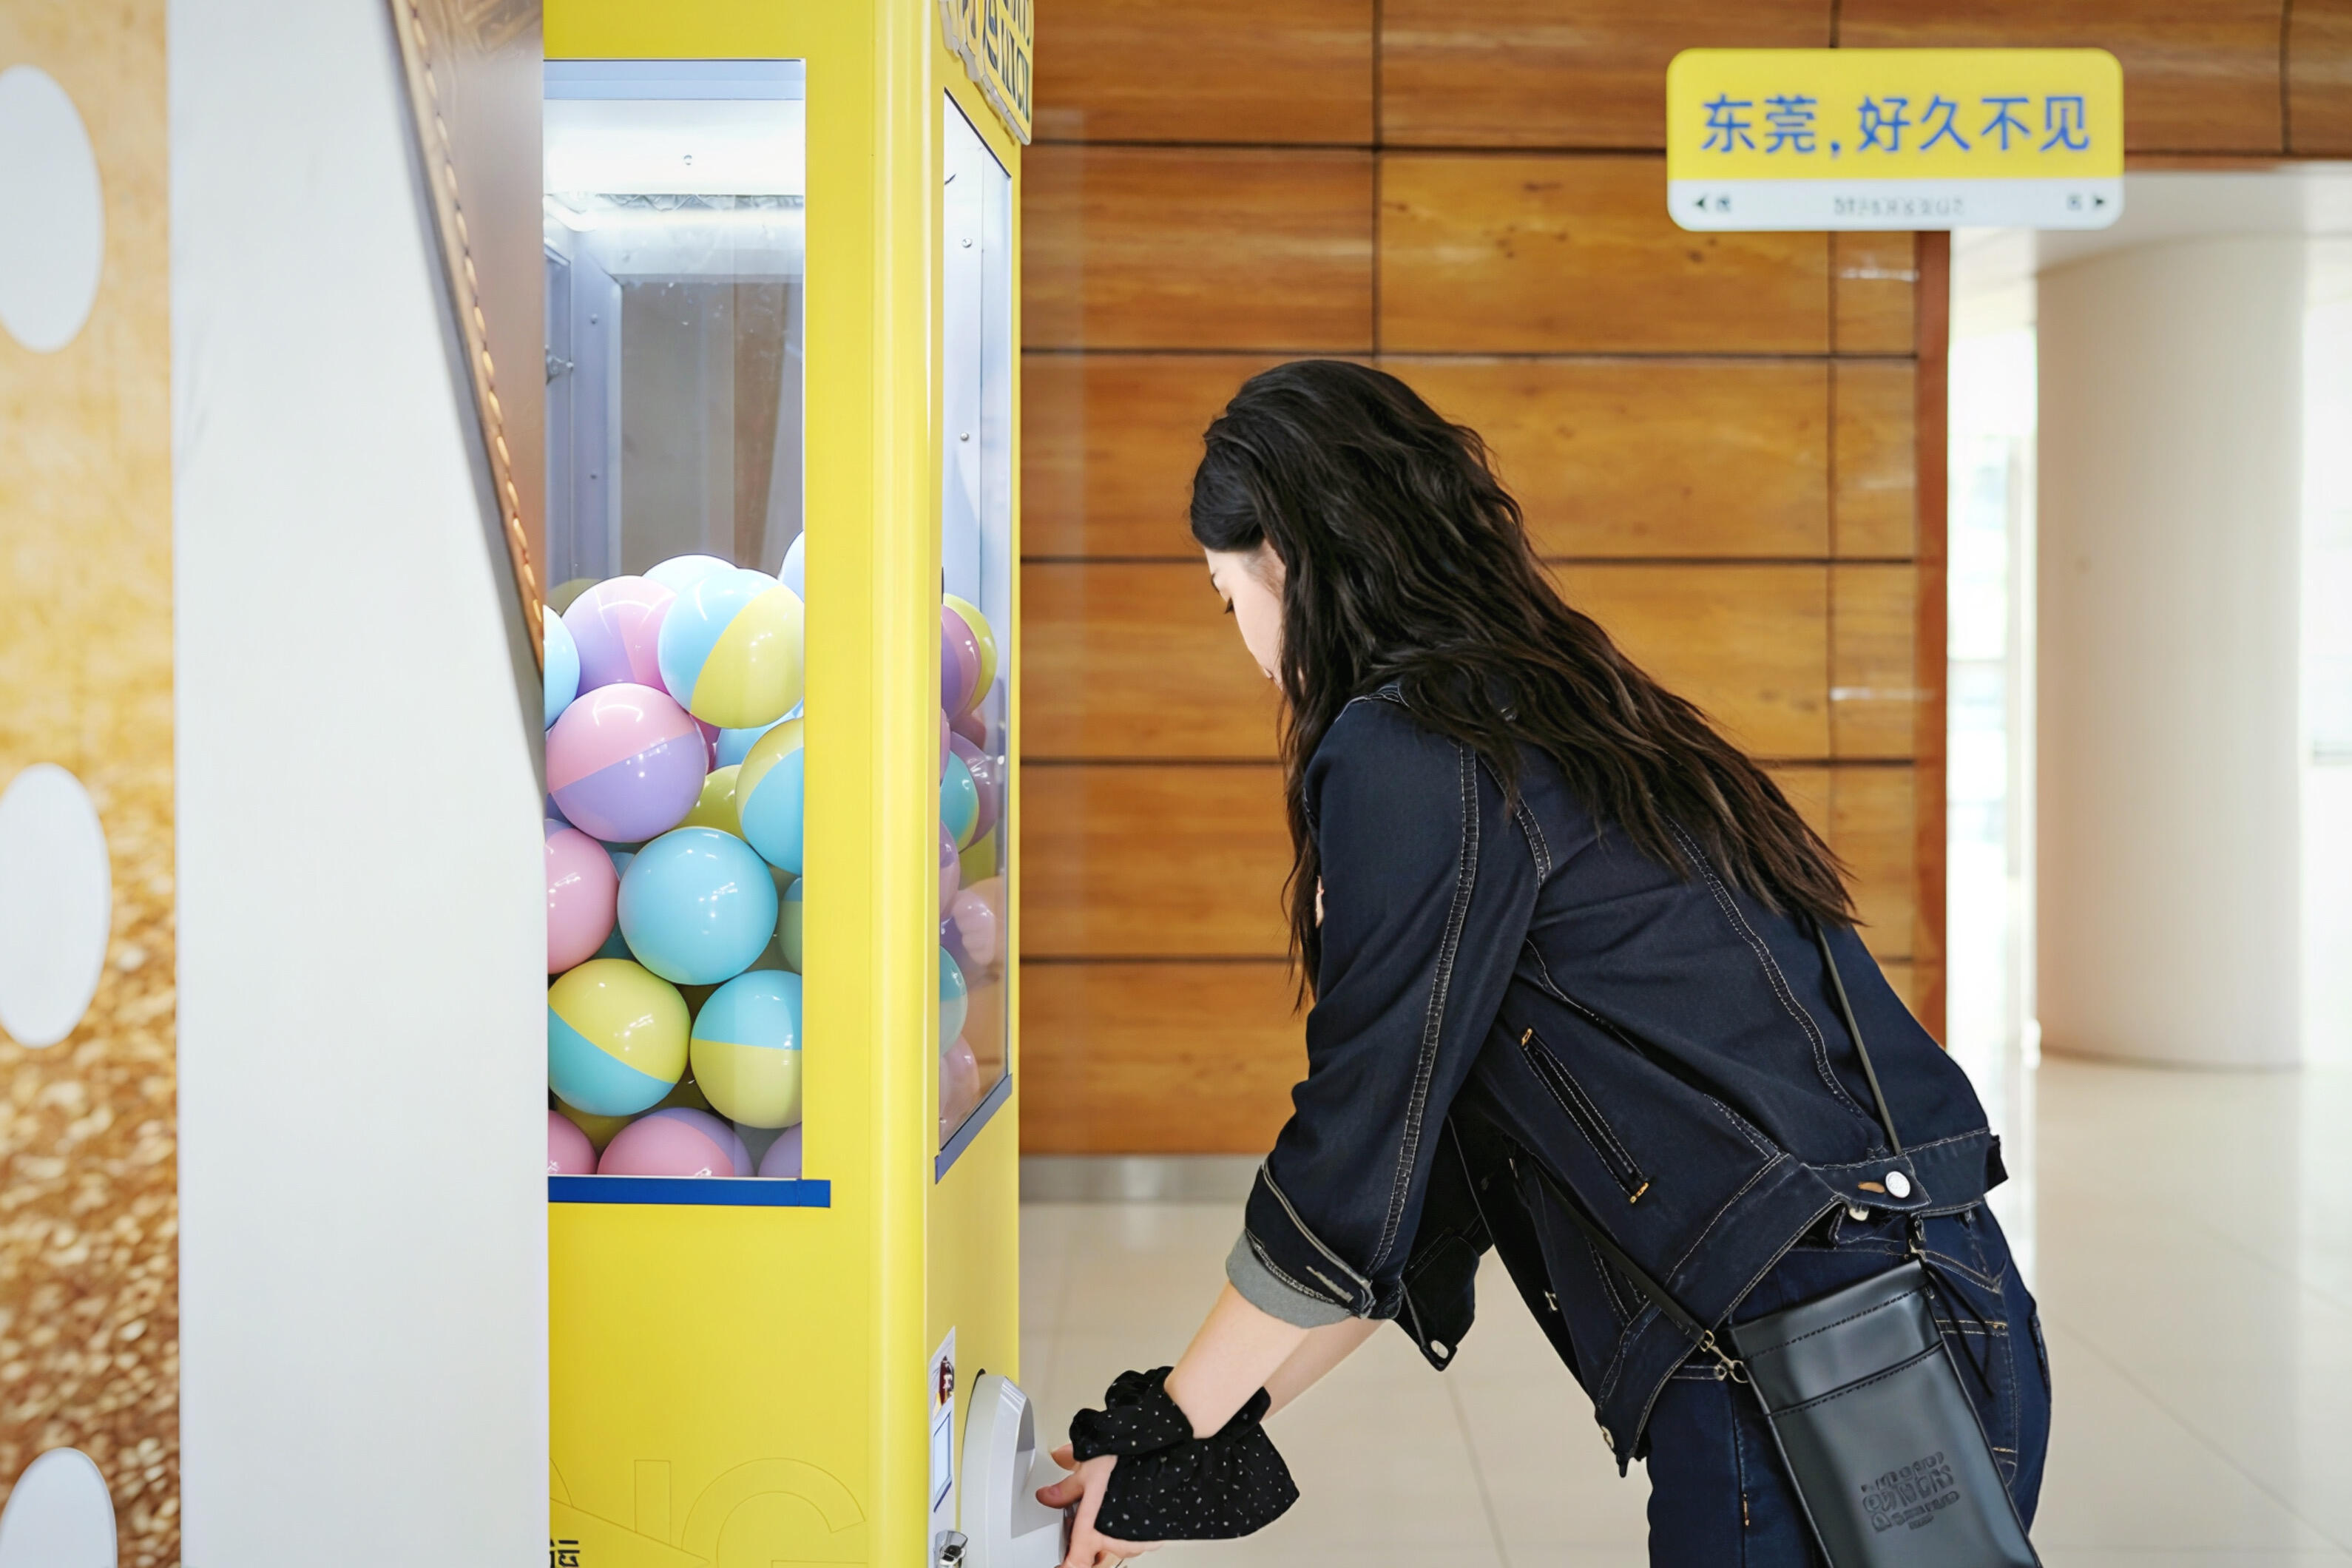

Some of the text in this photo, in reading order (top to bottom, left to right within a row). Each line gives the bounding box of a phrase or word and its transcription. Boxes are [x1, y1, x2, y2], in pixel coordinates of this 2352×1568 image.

[1700, 93, 2091, 158] 东莞,好久不见
